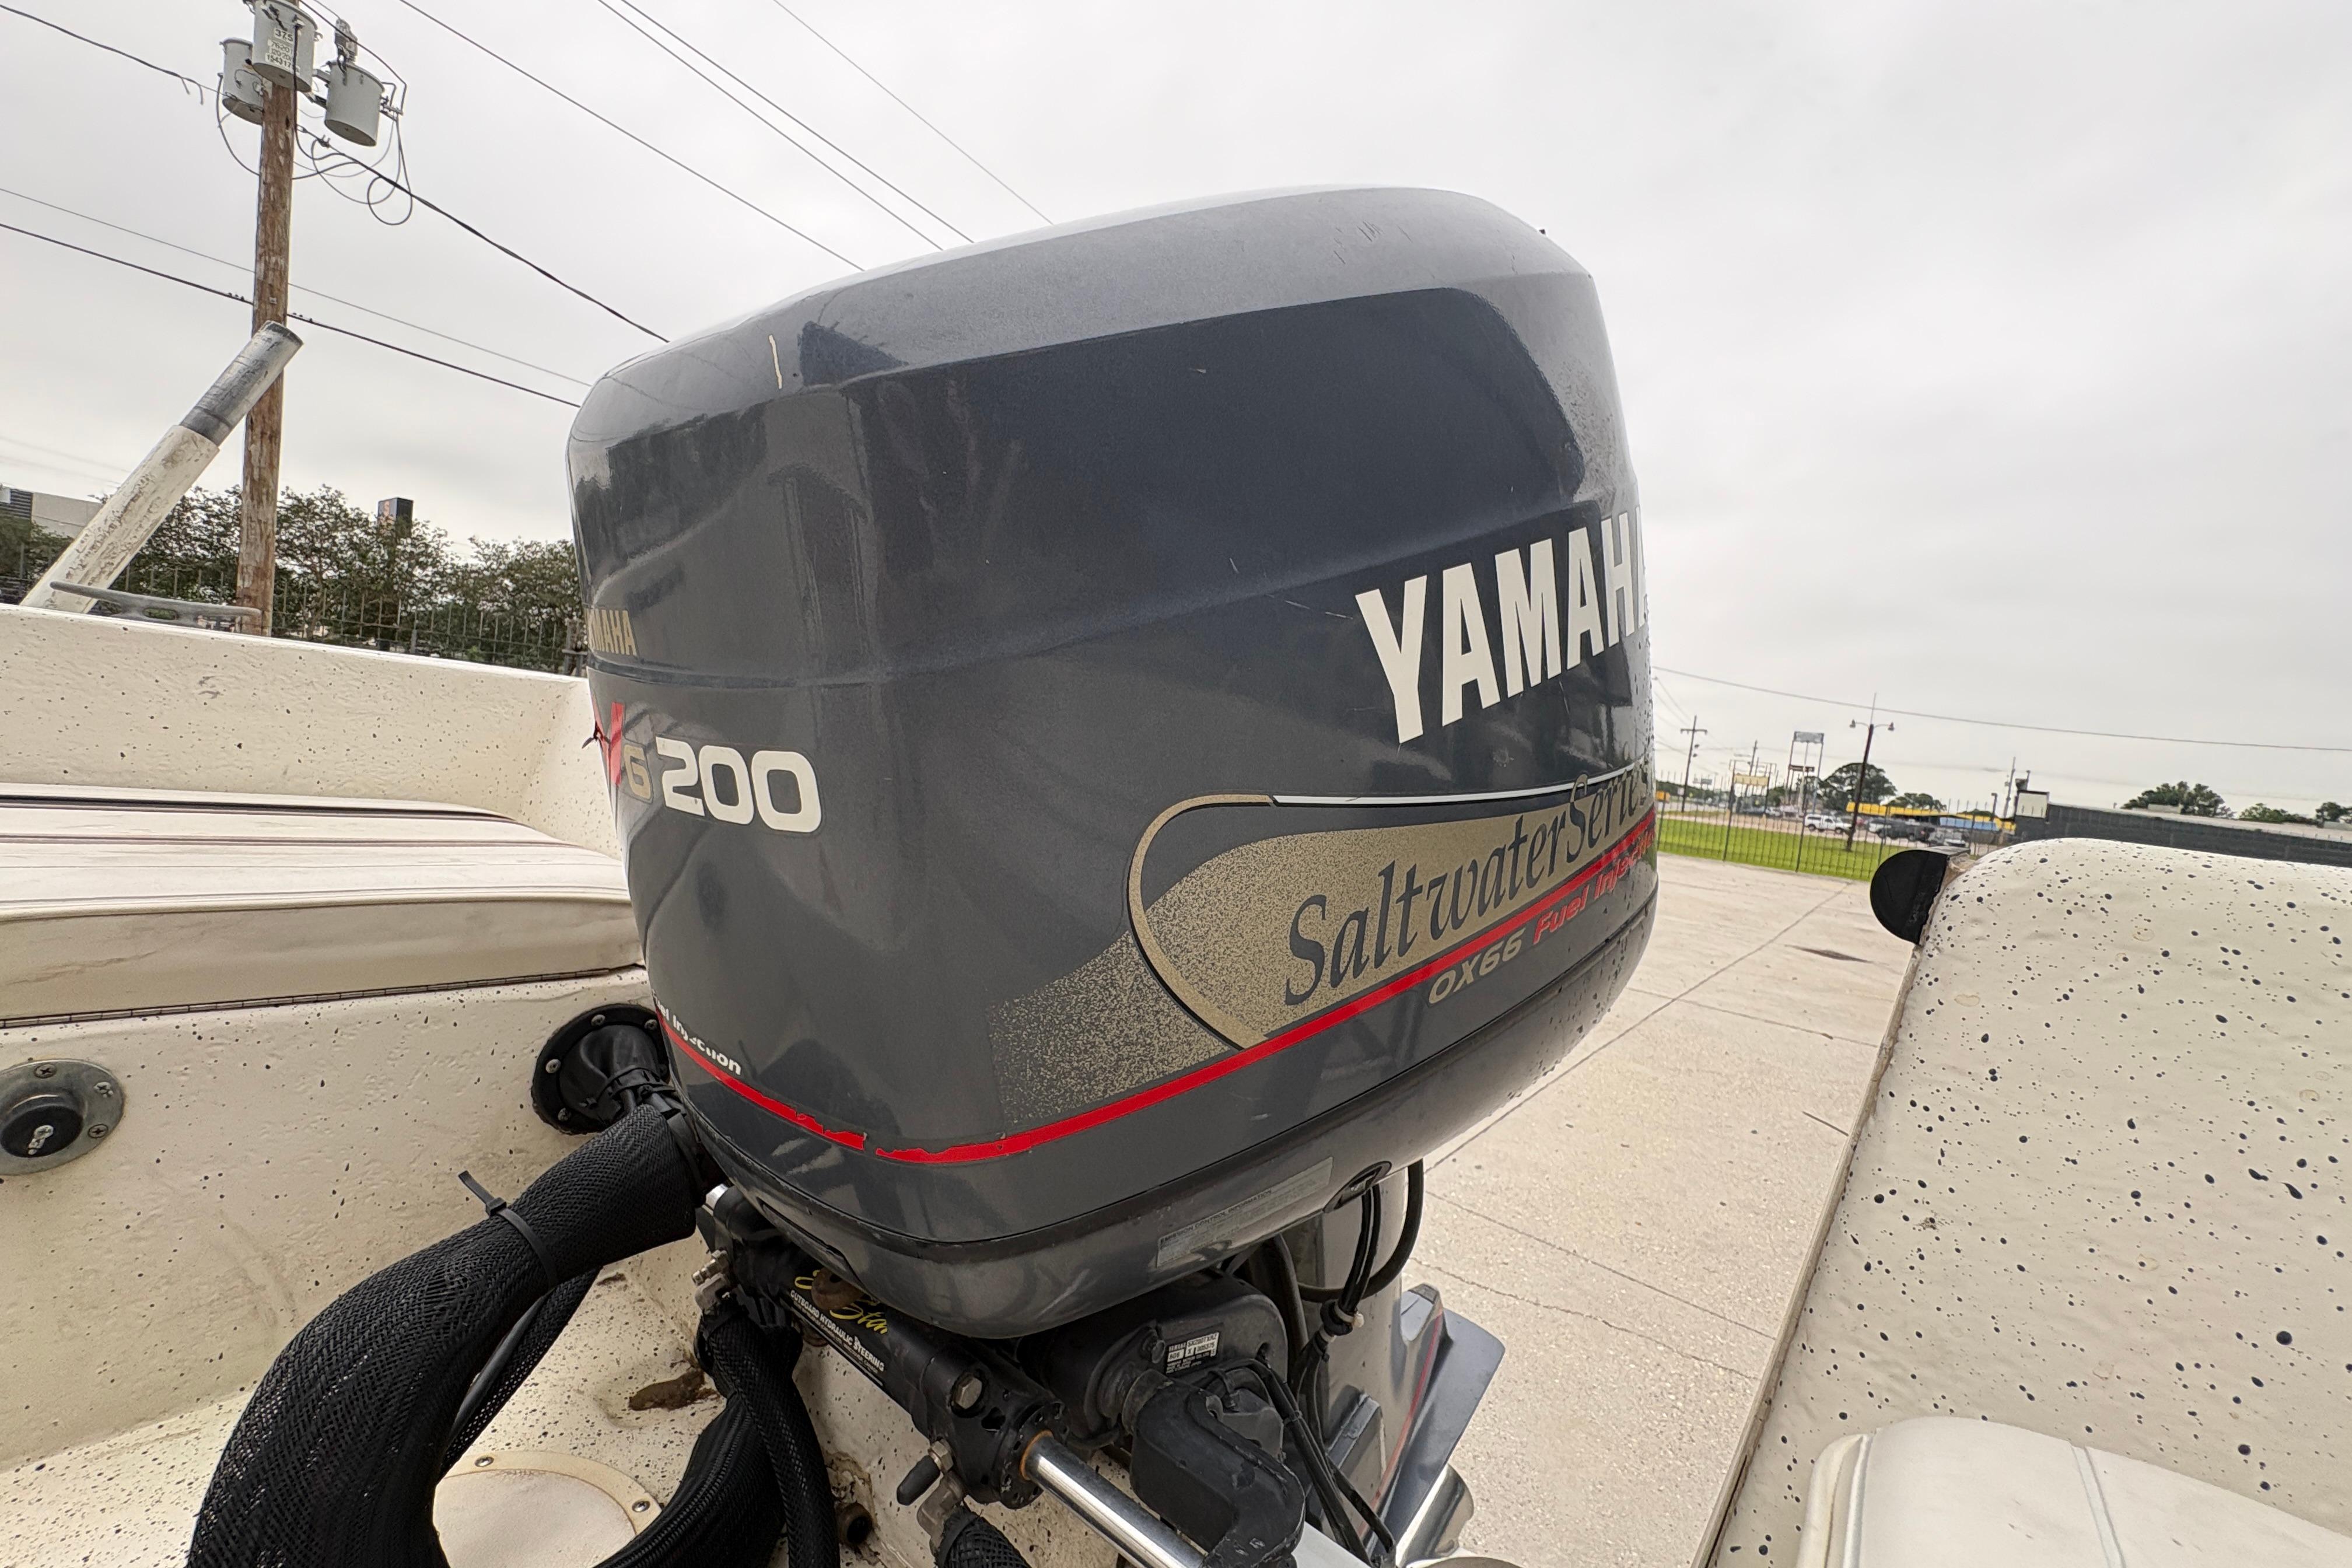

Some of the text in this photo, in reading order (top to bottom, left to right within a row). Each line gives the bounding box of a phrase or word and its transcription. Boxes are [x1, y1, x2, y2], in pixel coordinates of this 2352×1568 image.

[655, 736, 822, 833] 200
[1427, 928, 1526, 1005] OX66
[1533, 884, 1590, 945] Fuel
[790, 1289, 820, 1319] OUTBOARD
[820, 1313, 853, 1346] HYDRAULIC
[853, 1339, 885, 1372] STEERING
